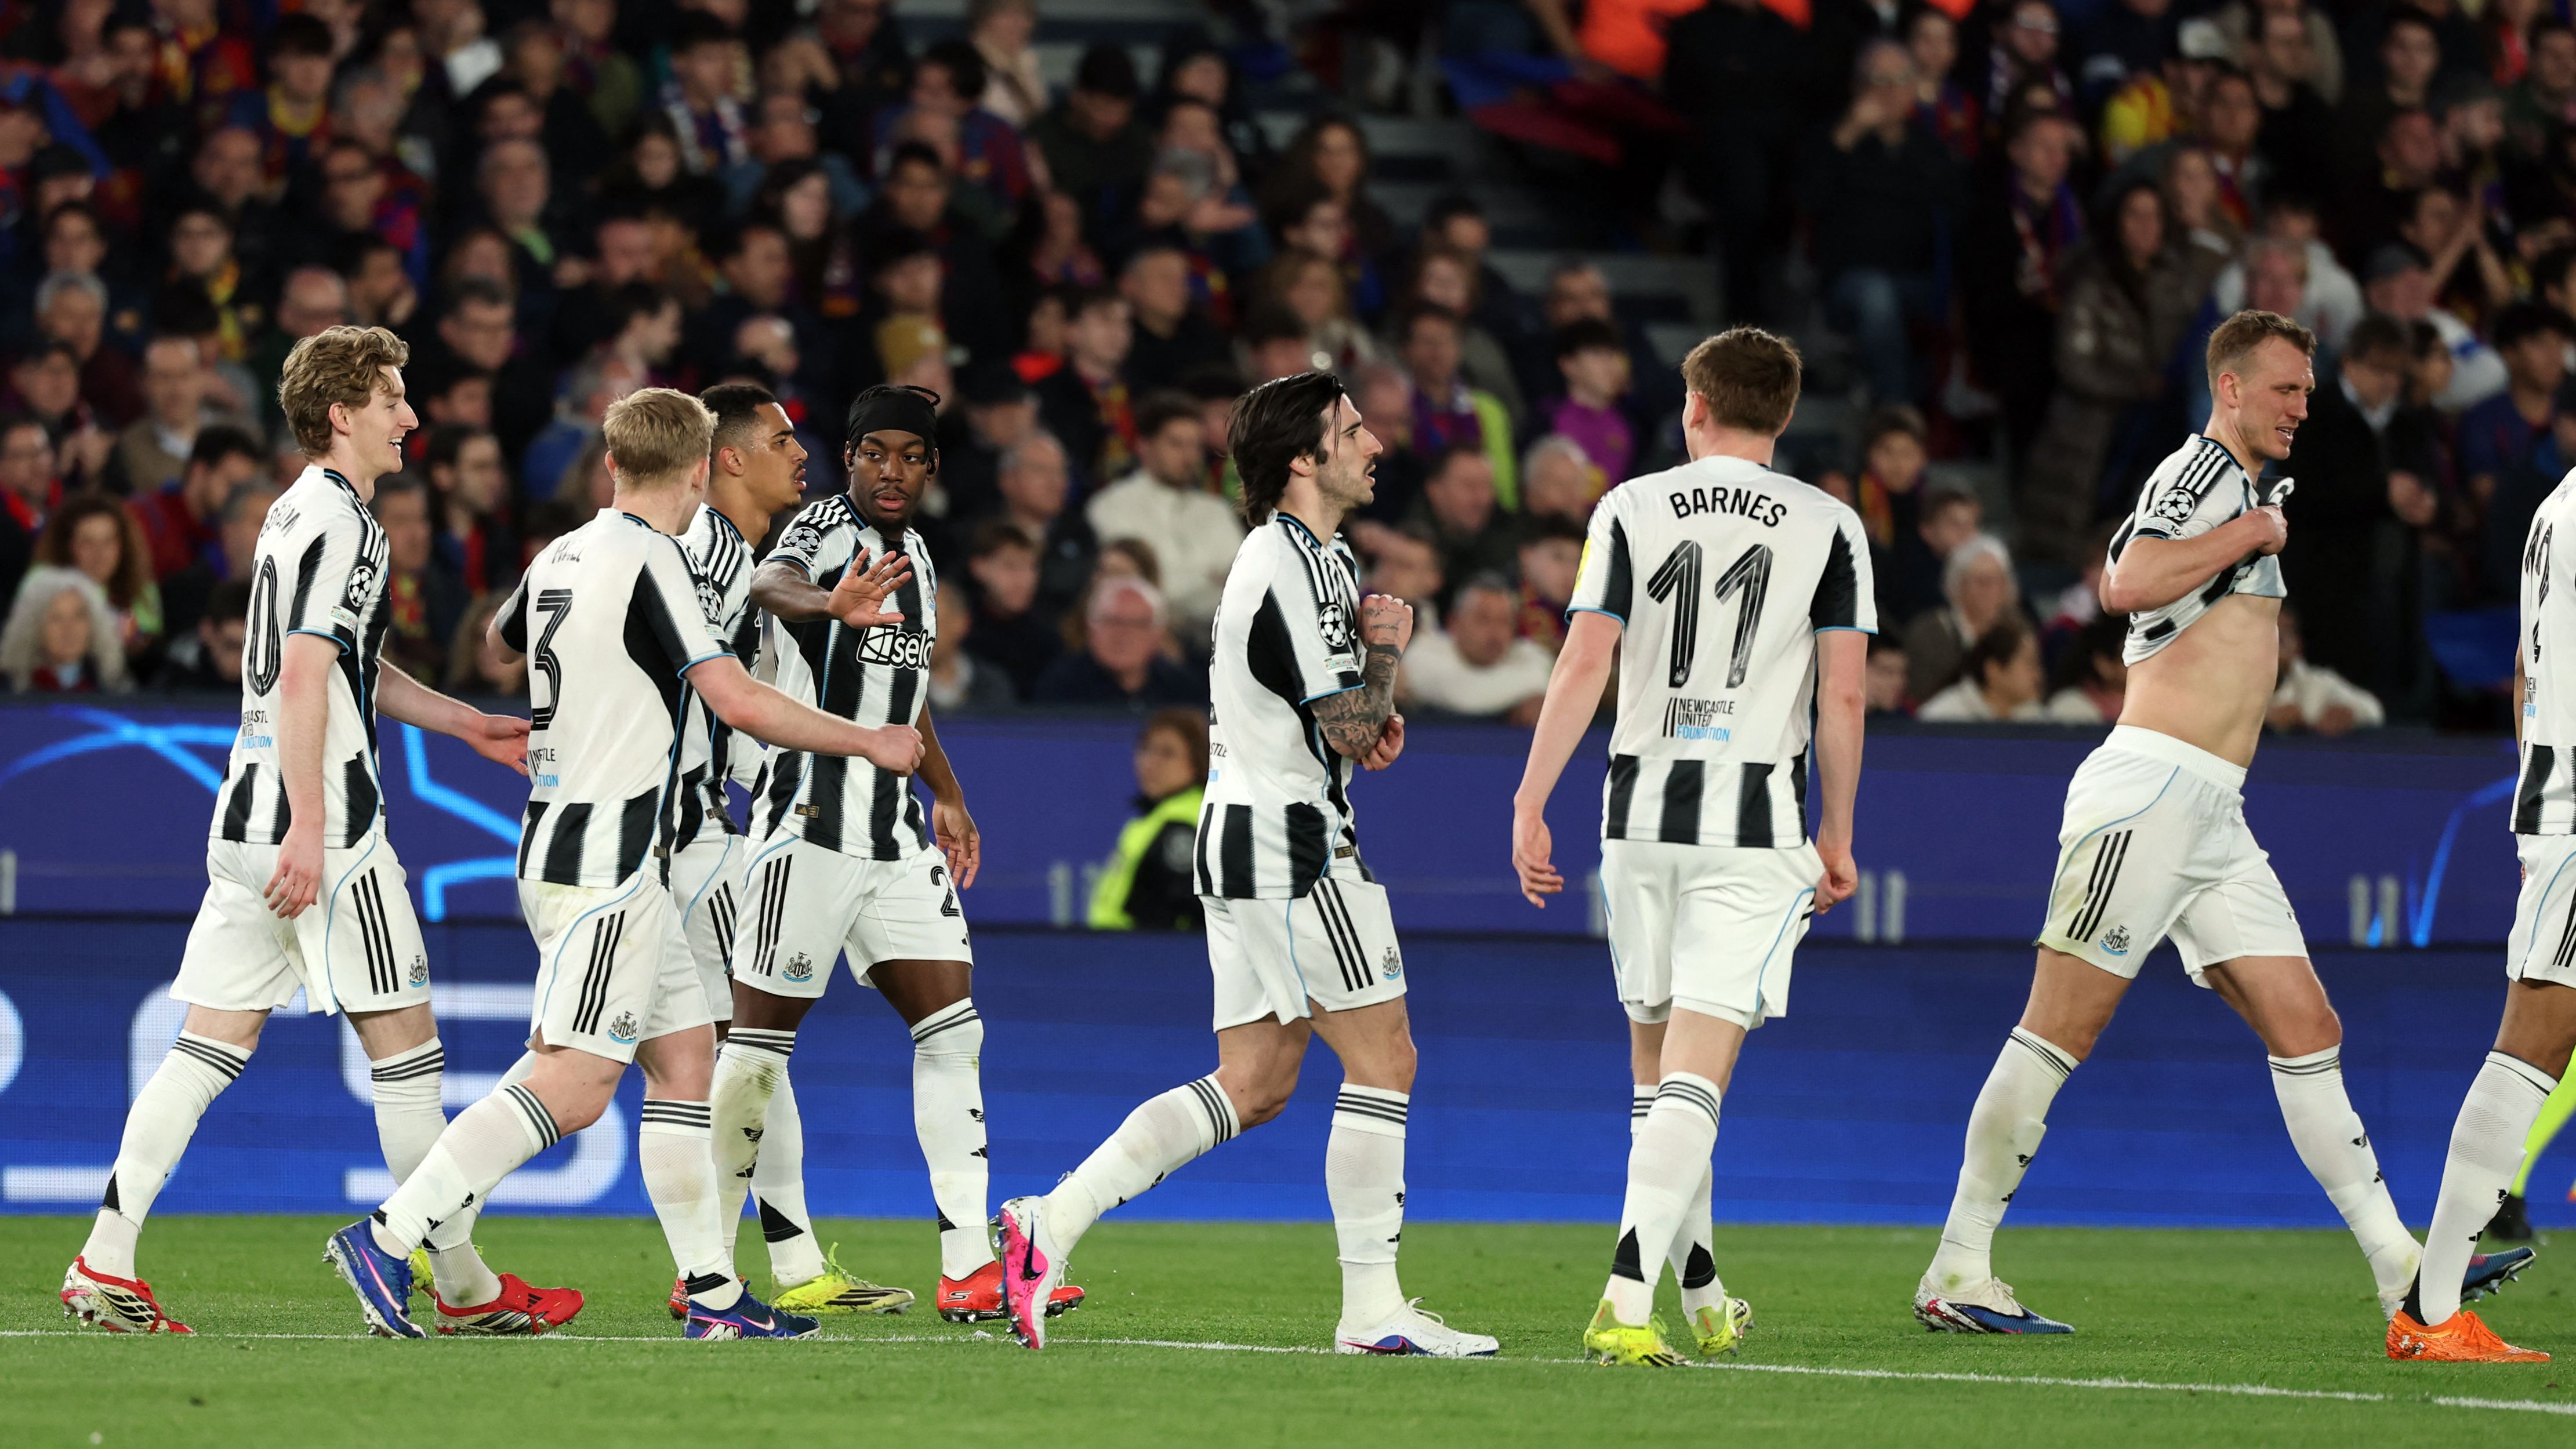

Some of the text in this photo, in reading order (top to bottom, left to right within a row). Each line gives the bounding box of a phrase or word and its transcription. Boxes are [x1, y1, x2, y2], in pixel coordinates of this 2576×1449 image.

[1669, 486, 1787, 528] BARNES
[243, 554, 281, 698] 0
[1646, 540, 1774, 689] 11
[529, 589, 574, 731] 3
[1677, 711, 1713, 728] UNITED
[1678, 698, 1736, 716] NEWCASTLE
[930, 865, 961, 917] 2
